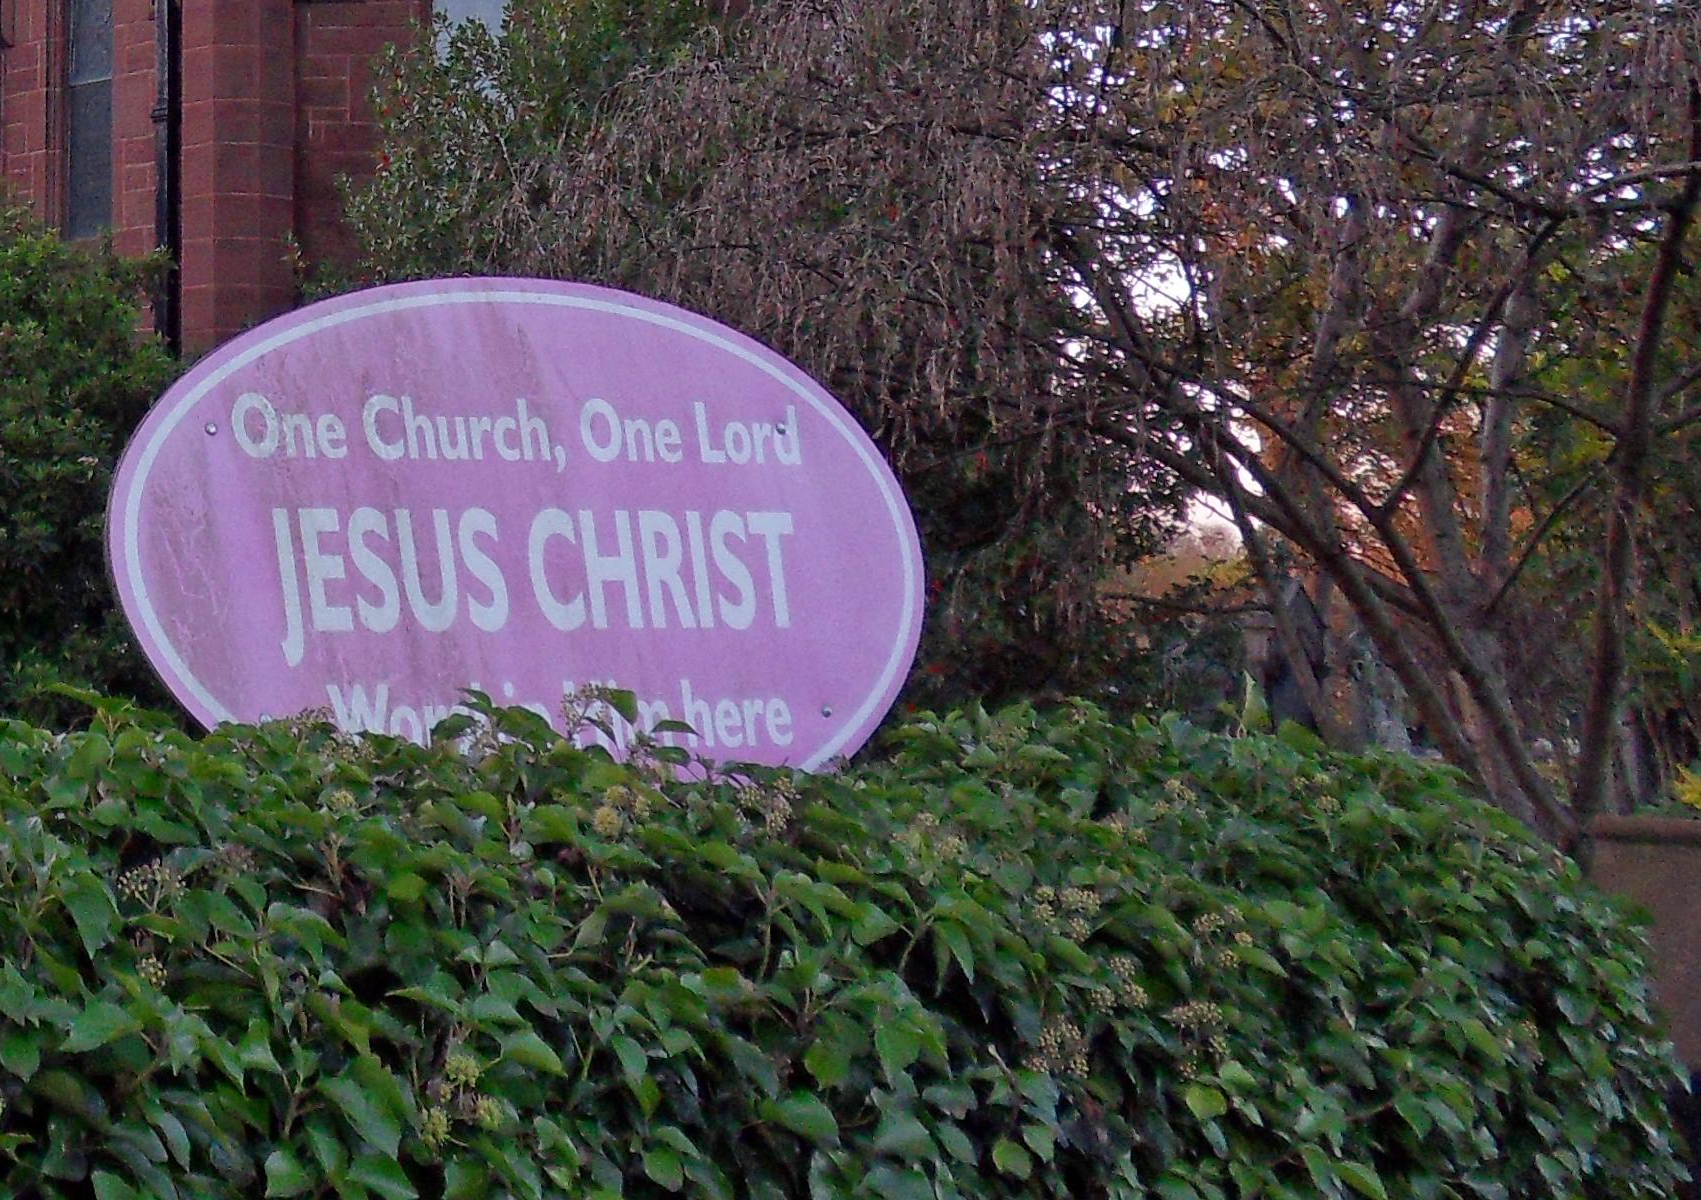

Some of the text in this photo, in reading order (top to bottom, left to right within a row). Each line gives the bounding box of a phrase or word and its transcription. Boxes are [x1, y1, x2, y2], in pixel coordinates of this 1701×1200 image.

[231, 392, 802, 473] One Church, One Lord
[272, 507, 794, 668] JESUS CHRIST
[680, 679, 795, 748] here
